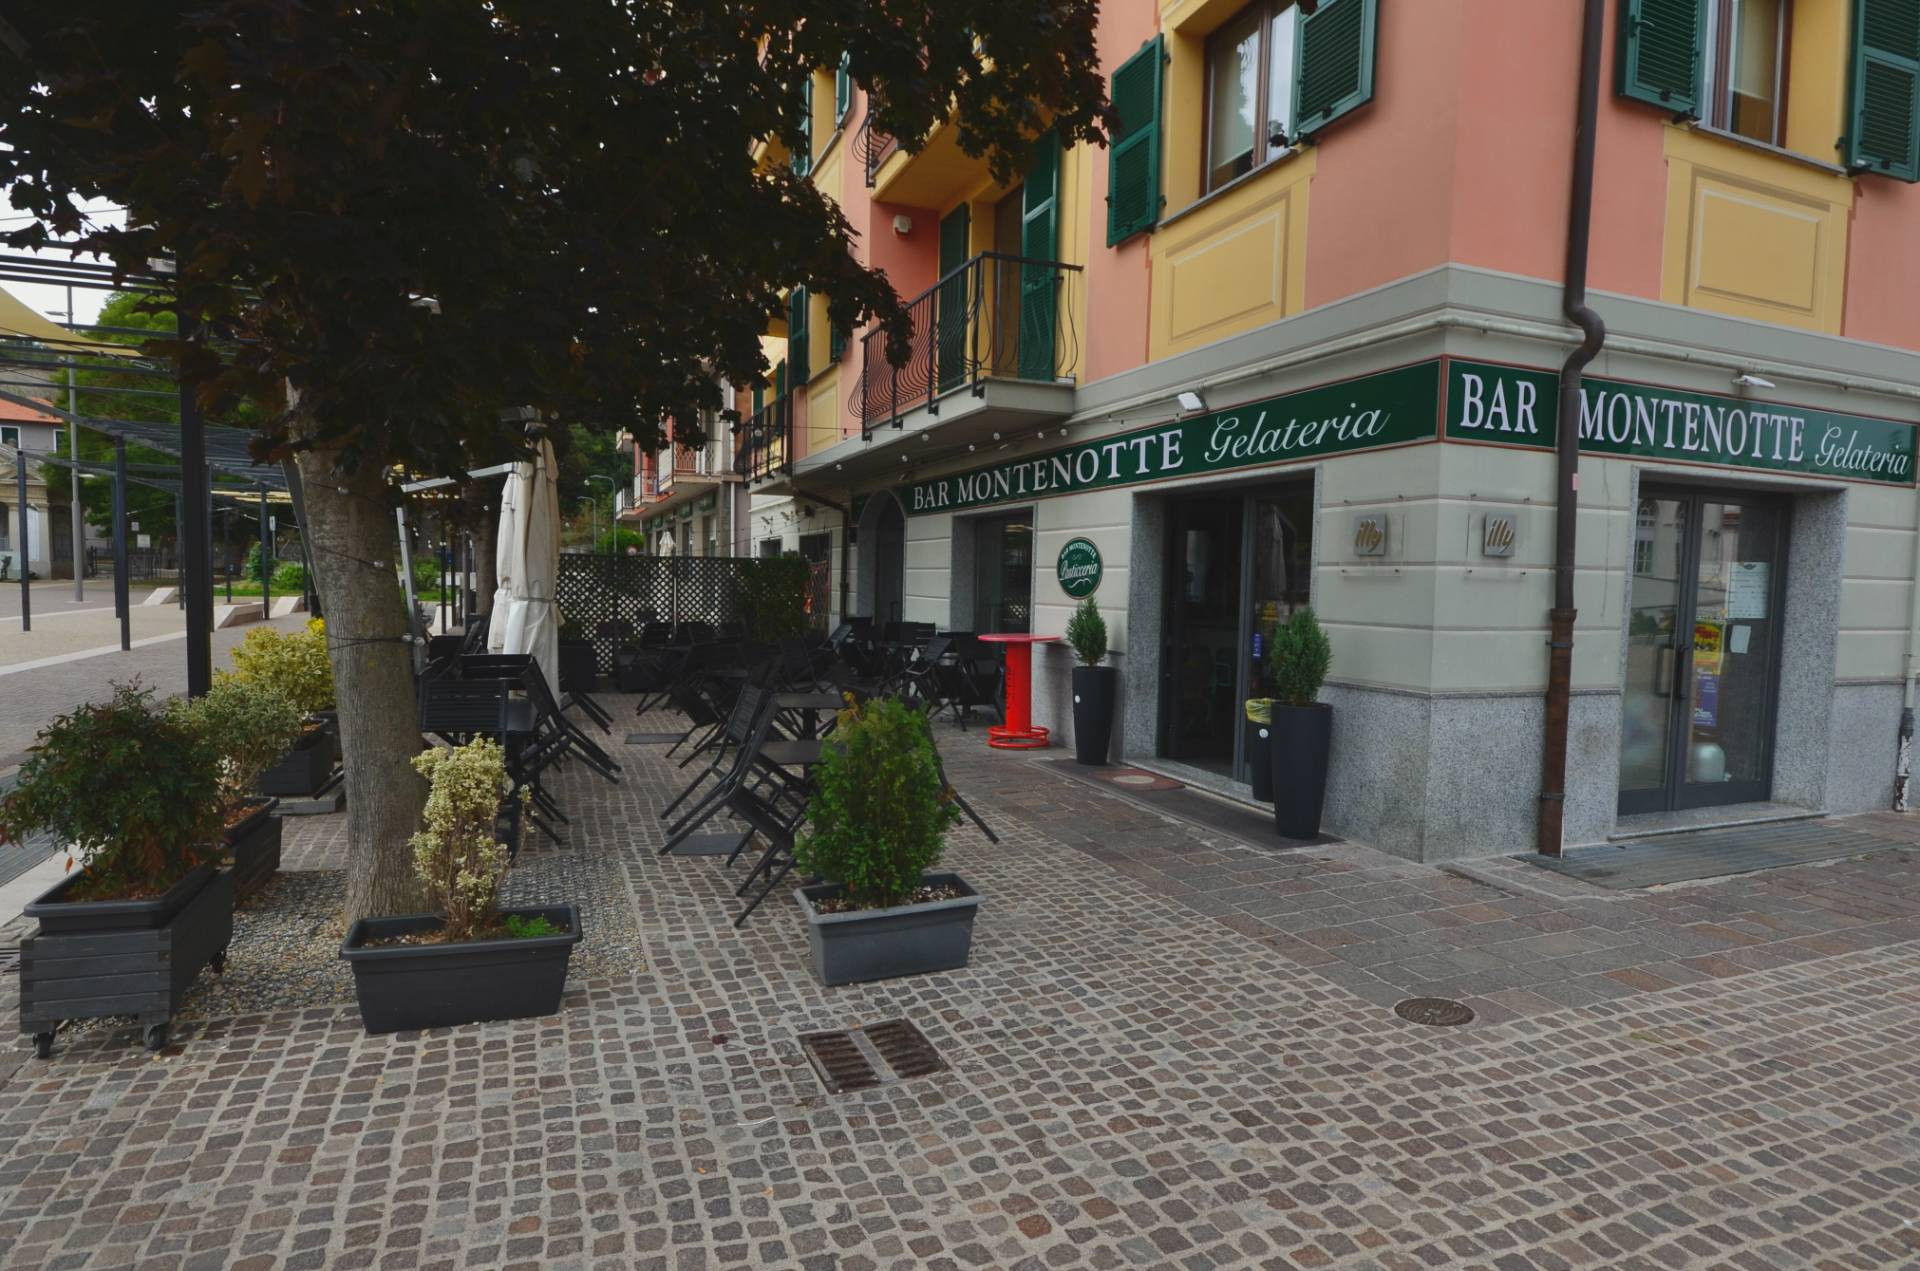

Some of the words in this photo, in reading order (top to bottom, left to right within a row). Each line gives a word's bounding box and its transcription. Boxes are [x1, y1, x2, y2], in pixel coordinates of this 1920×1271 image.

[1460, 373, 1538, 434] BAR
[1578, 388, 1805, 462] MONTENOTTE
[1815, 420, 1910, 475] Gelateria
[913, 477, 950, 511] BAR
[957, 428, 1184, 504] MONTENOTTE
[1204, 402, 1391, 463] Gelateria
[1355, 519, 1383, 553] illy
[1487, 519, 1514, 553] illy
[1060, 559, 1098, 580] Pasticceria
